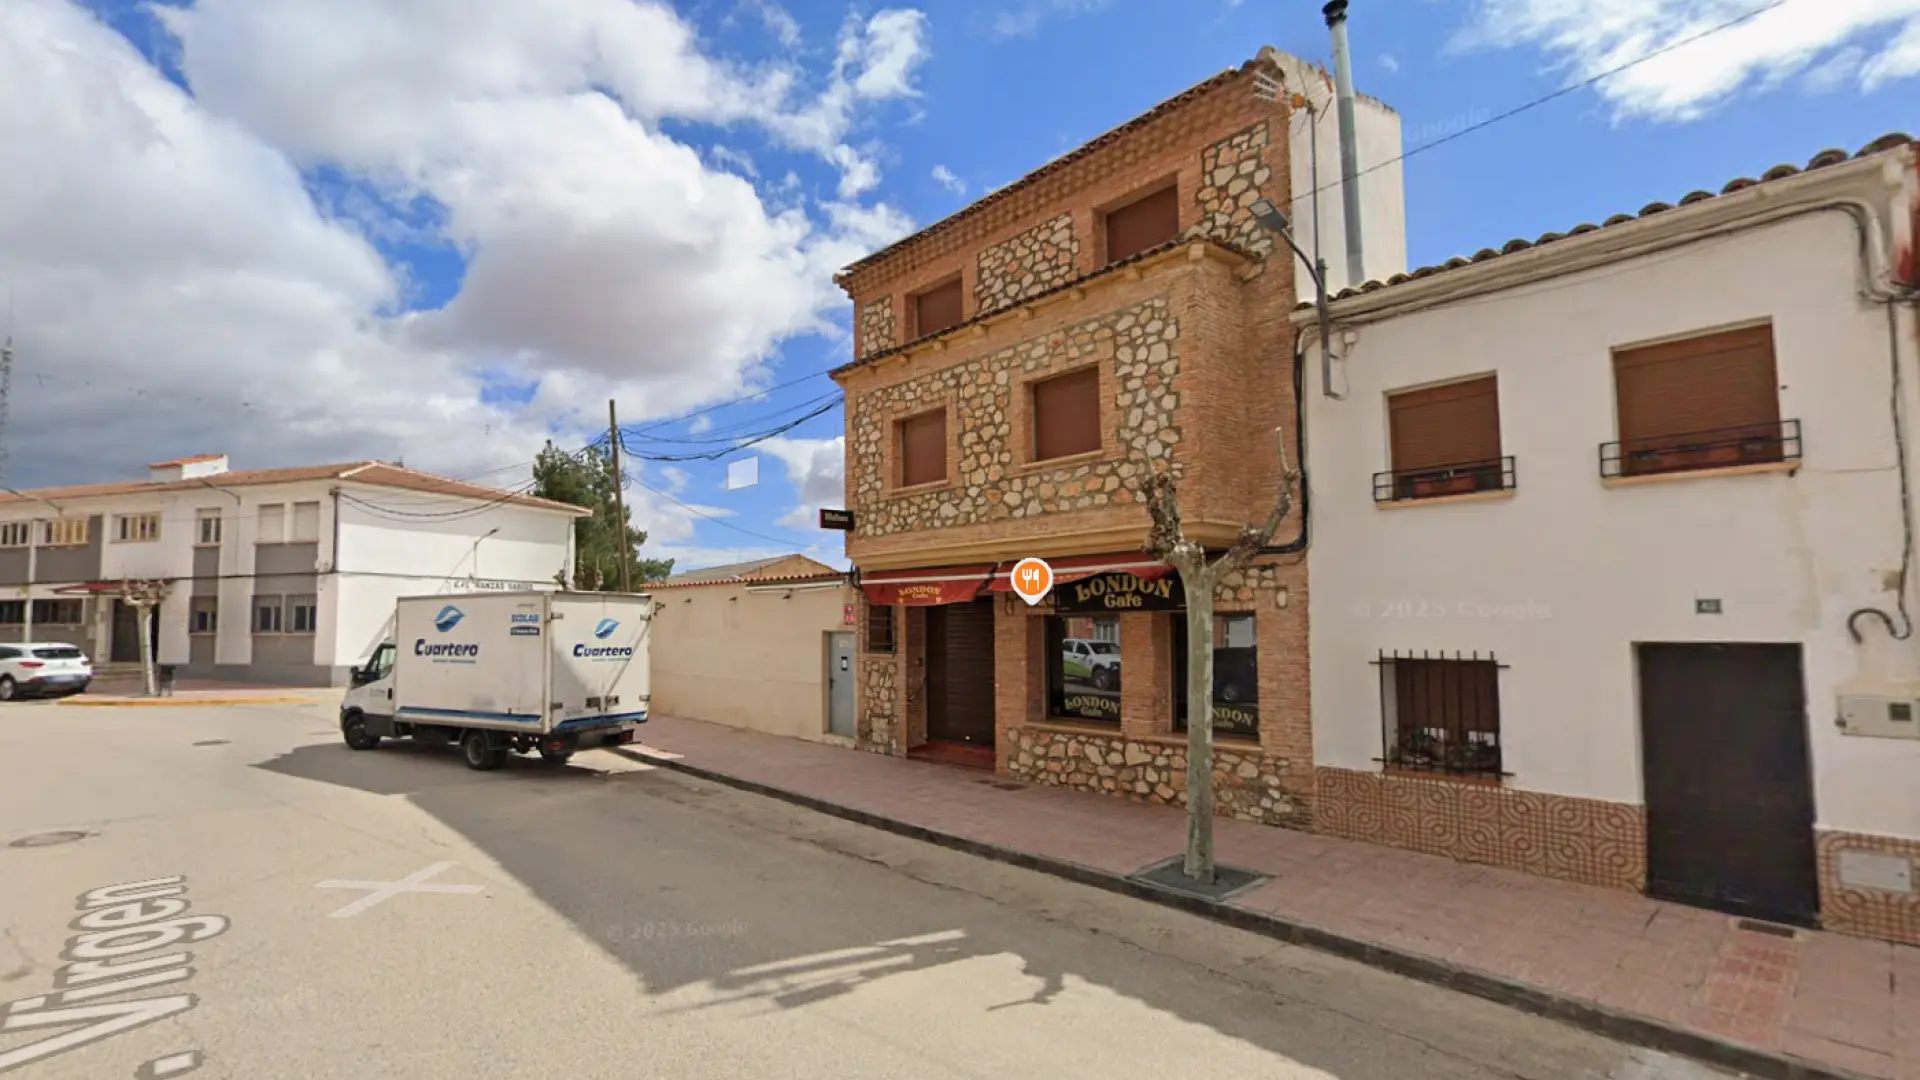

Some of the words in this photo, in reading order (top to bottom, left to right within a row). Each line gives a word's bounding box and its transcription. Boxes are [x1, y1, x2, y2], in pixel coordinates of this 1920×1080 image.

[1075, 574, 1173, 602] LONDON
[414, 639, 479, 657] Cuartero
[573, 644, 632, 657] Cuartero
[1064, 696, 1120, 715] LONDON
[1211, 707, 1253, 726] NDON
